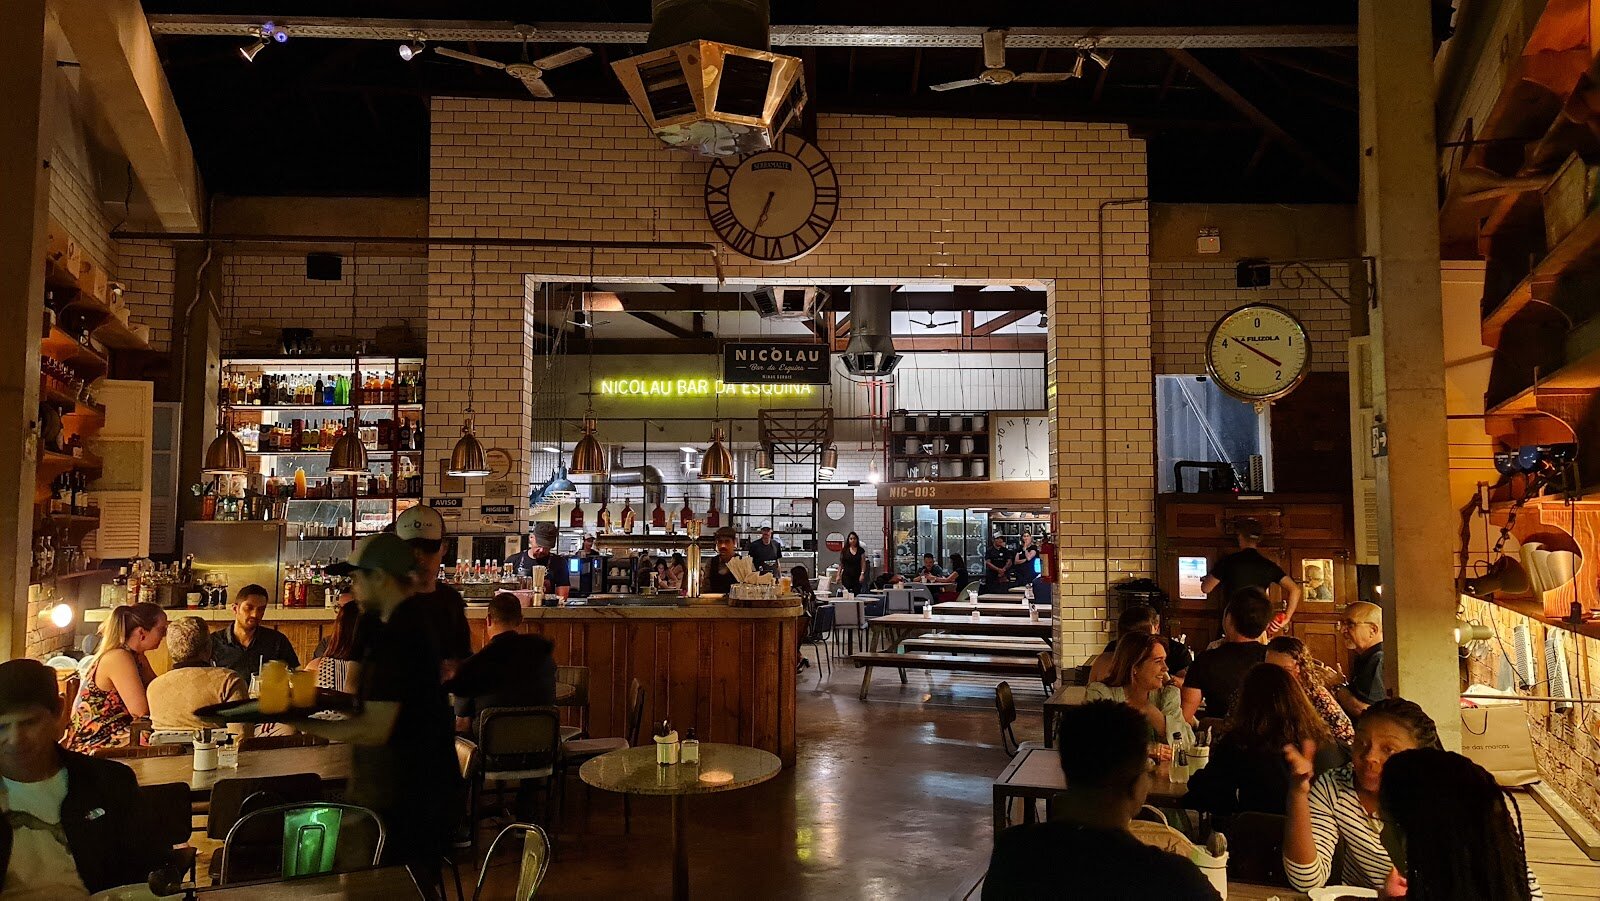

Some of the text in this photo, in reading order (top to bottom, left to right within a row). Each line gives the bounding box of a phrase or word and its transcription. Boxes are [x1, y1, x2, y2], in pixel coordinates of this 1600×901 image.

[1254, 318, 1260, 328] 0
[1221, 338, 1229, 348] 4
[735, 349, 819, 362] NICOLAU
[749, 363, 765, 371] Bar
[778, 363, 805, 374] Esquina
[1234, 371, 1241, 381] 3
[1275, 370, 1282, 380] 2
[601, 379, 811, 395] NICOLAU BAR DA ESQUINA
[889, 486, 936, 498] NIC-003
